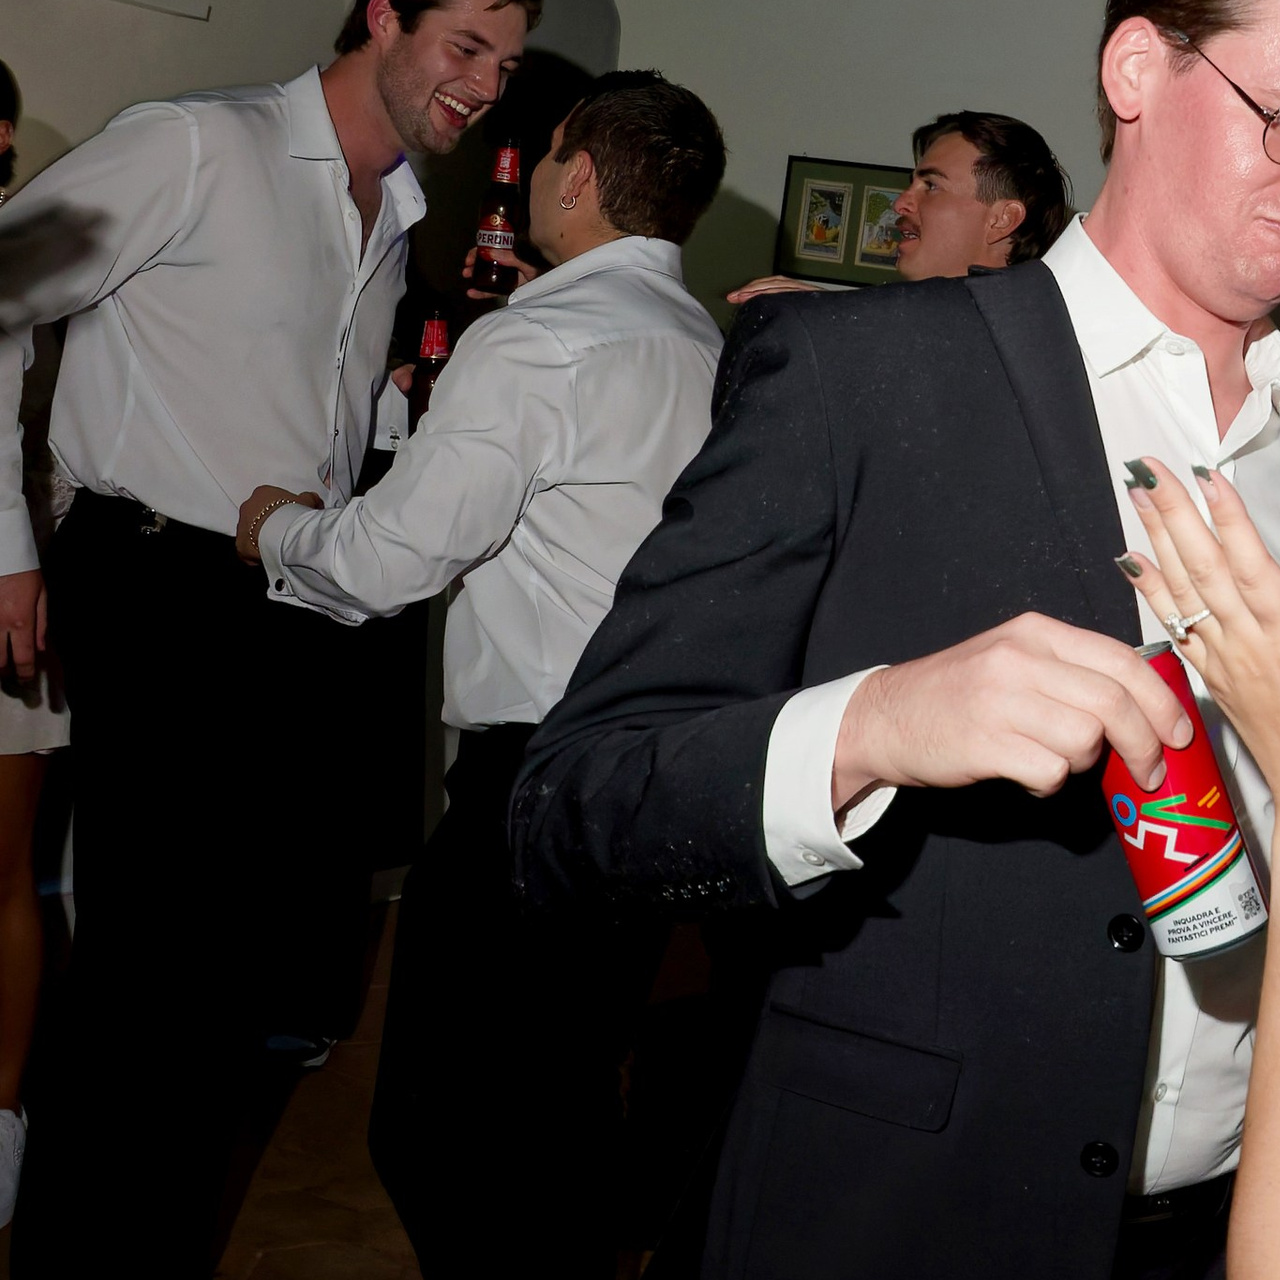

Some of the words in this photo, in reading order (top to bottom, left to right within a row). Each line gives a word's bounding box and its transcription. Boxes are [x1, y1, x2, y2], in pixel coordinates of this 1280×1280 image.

[477, 232, 513, 246] PERONI
[1167, 926, 1191, 936] PROVA
[1198, 910, 1233, 928] VINCERE
[1173, 910, 1214, 926] INQUADRA
[1167, 930, 1208, 944] FANTASTICI
